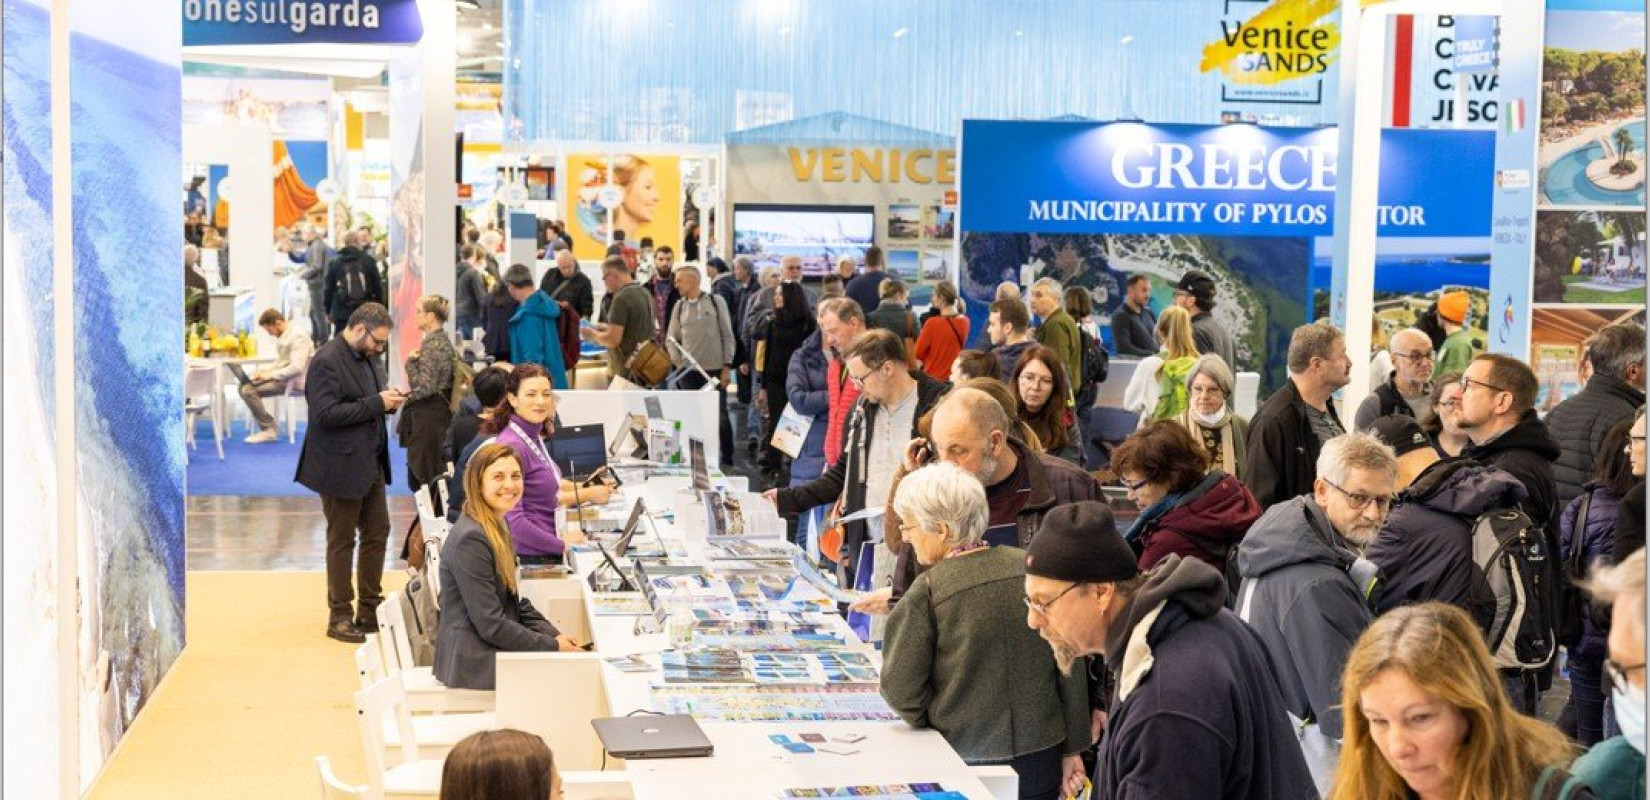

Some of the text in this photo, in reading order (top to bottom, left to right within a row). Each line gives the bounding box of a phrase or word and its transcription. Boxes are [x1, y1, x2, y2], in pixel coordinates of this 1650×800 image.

[1220, 20, 1329, 51] Venice
[1242, 51, 1327, 73] SANDS
[787, 146, 956, 184] VENICE
[1111, 142, 1338, 192] GREECE
[1028, 200, 1207, 223] MUNICIPALITY
[1213, 202, 1246, 223] OF
[1252, 203, 1327, 225] PYLOS
